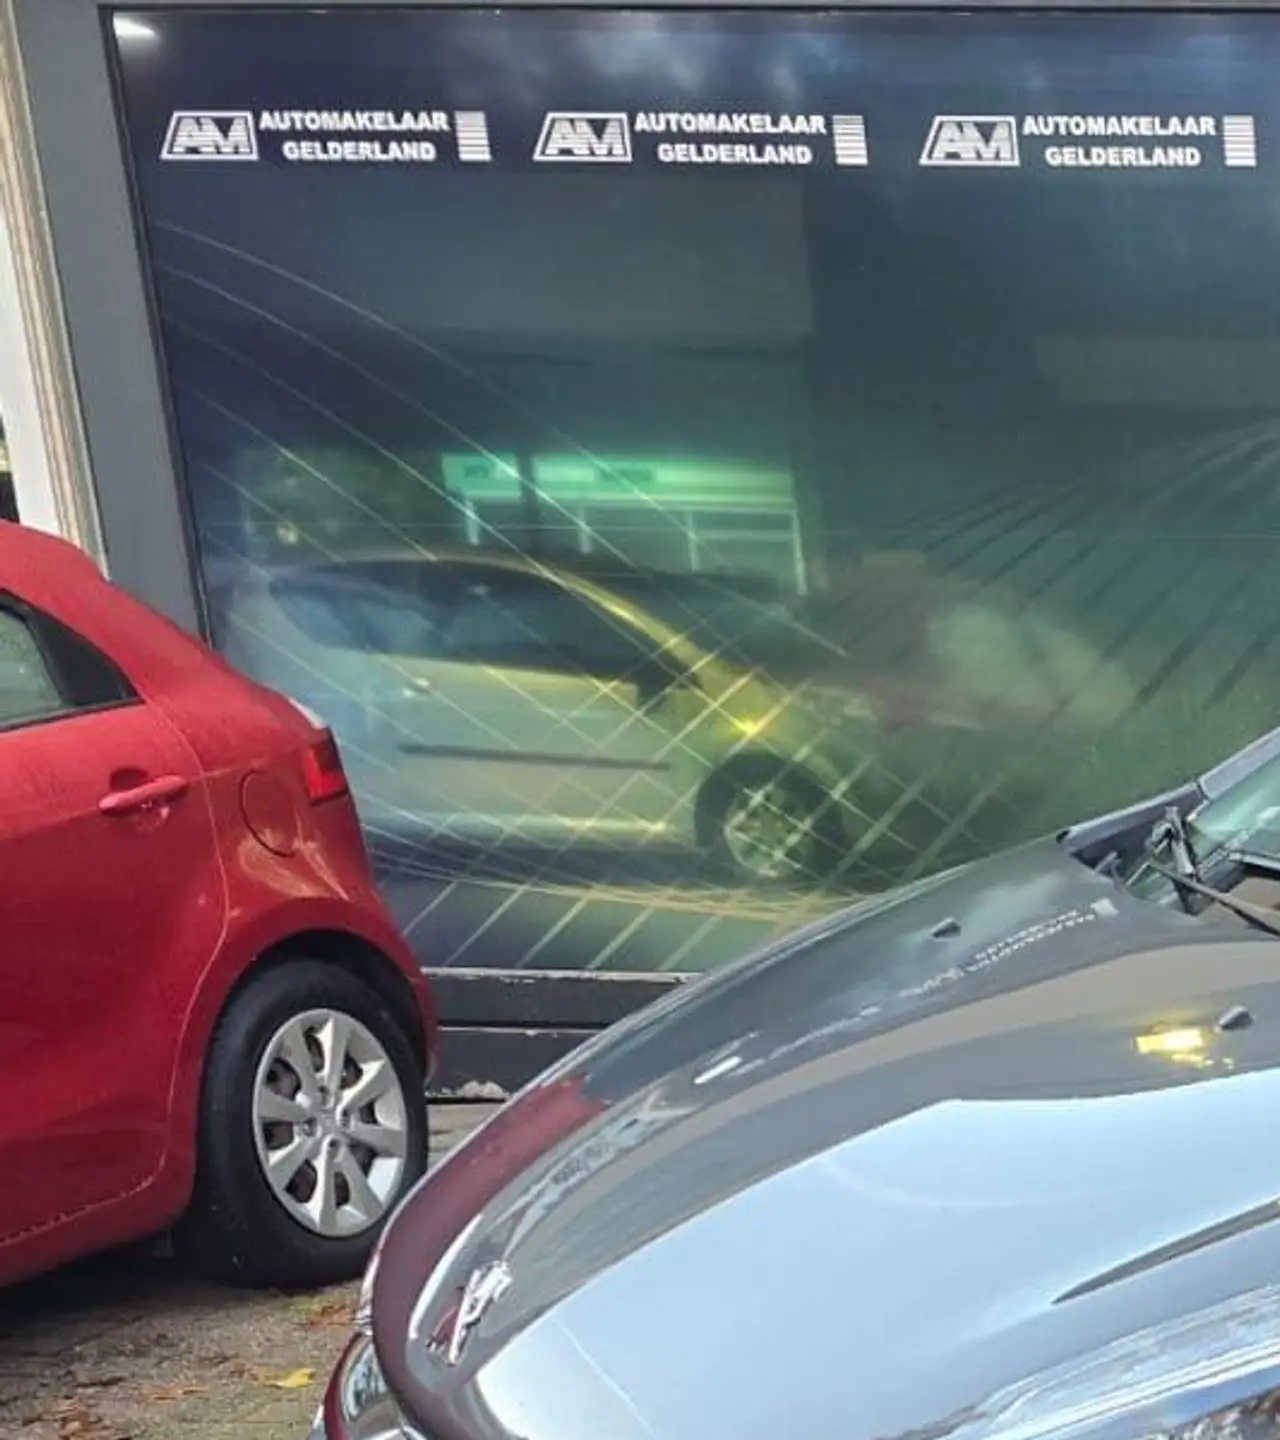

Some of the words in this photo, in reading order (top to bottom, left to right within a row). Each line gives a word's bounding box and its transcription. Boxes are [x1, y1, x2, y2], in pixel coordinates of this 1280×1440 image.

[258, 110, 449, 131] AUTOMAKELAAR
[633, 111, 827, 135] AUTOMAKELAAR
[1022, 114, 1216, 136] AUTOMAKELAAR
[171, 116, 251, 154] AM
[544, 118, 625, 156] AM
[931, 120, 1012, 161] AM
[282, 141, 437, 162] GELDERLAND
[657, 143, 813, 165] GELDERLAND
[1044, 146, 1202, 167] GELDERLAND
